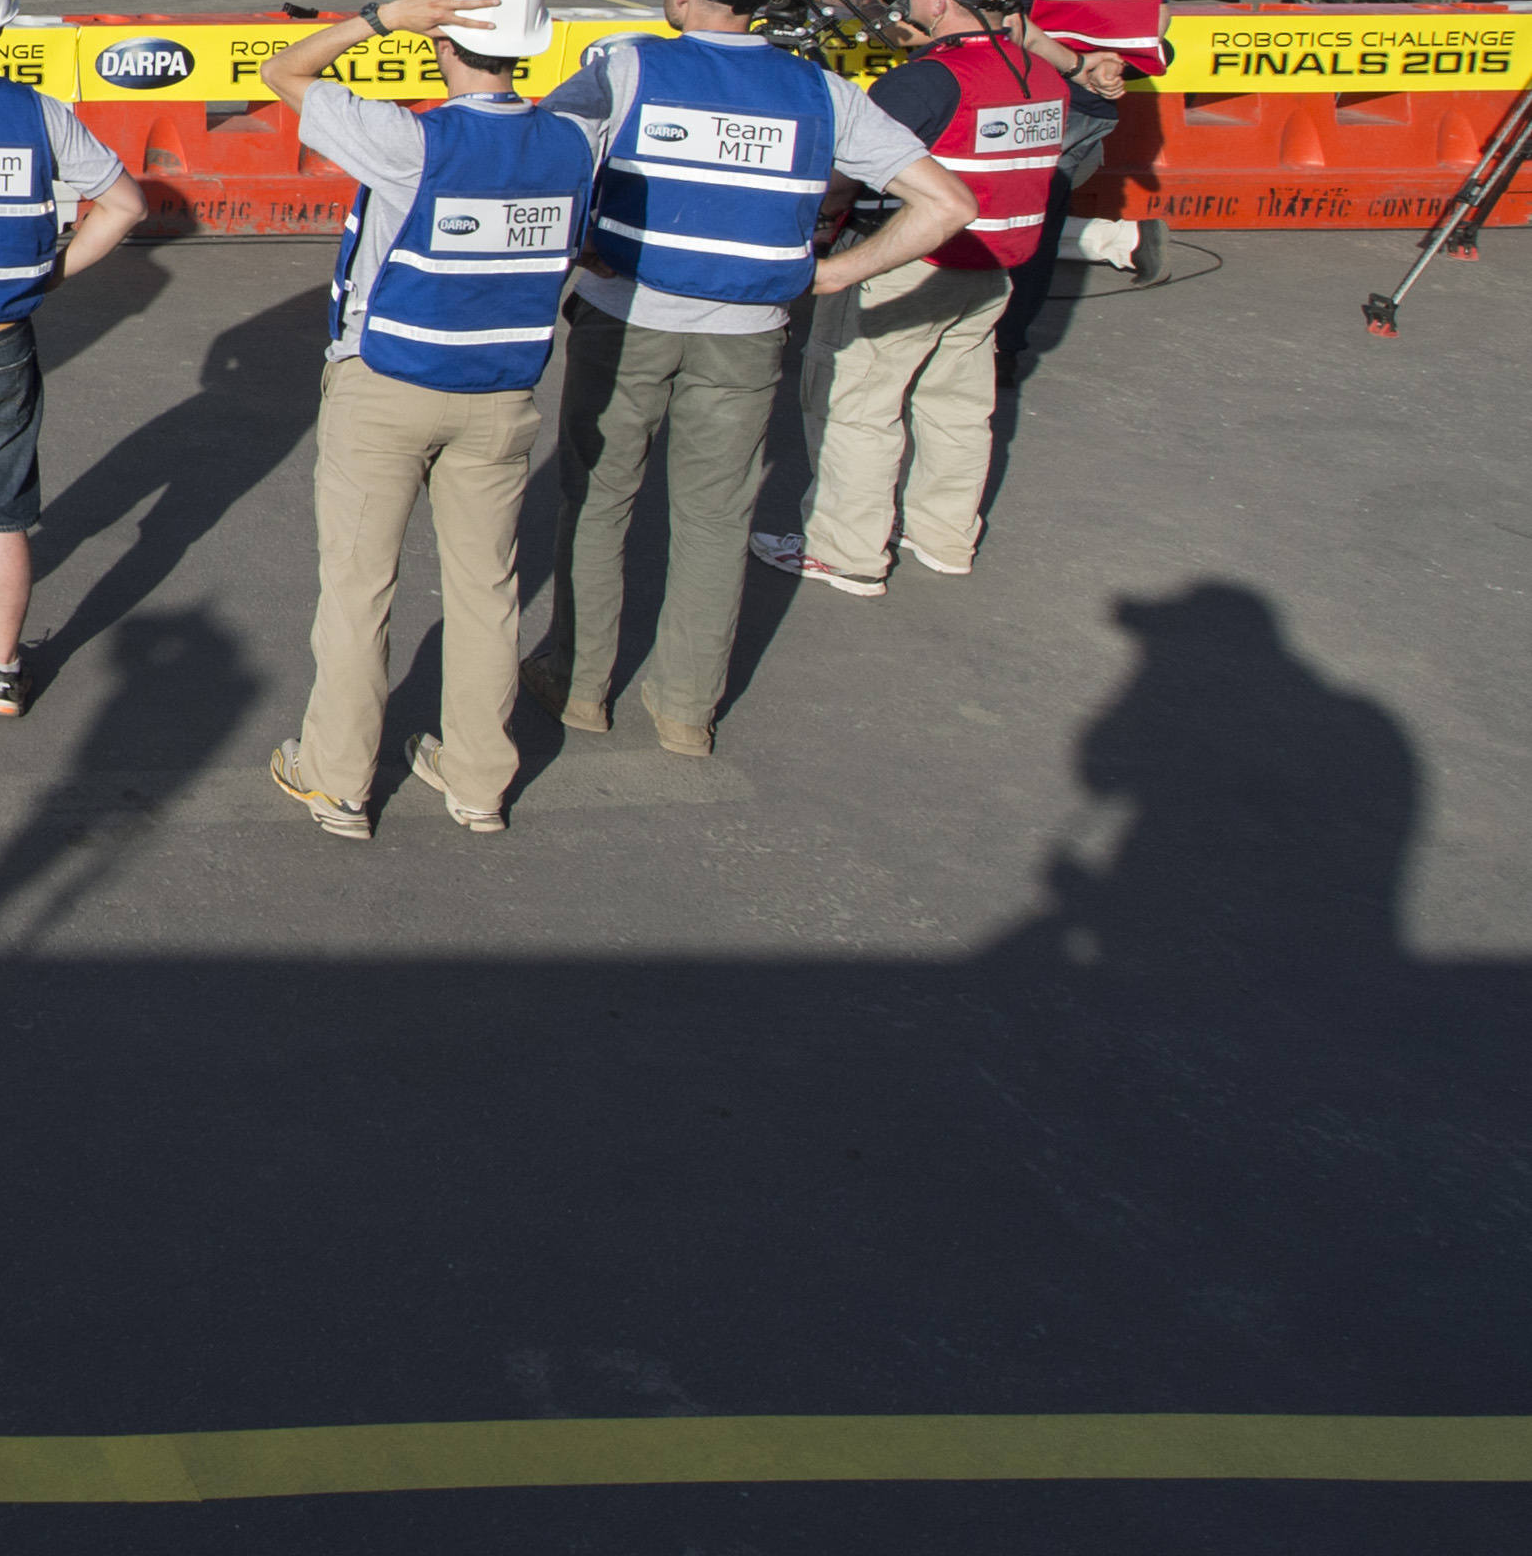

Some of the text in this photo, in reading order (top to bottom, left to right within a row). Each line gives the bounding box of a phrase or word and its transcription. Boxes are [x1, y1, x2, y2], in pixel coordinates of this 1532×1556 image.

[231, 39, 369, 56] ROBS
[1212, 31, 1516, 47] ROBOTICS CHALLENGE
[101, 50, 188, 77] DARPA
[232, 59, 405, 83] FALS
[1211, 51, 1512, 75] FINALS 2015
[1014, 107, 1061, 125] Course
[645, 124, 686, 140] DARPA
[711, 116, 783, 143] Team
[1014, 124, 1059, 144] Official
[718, 140, 772, 164] MIT
[161, 201, 348, 223] PACIFIC TRAFFI
[502, 204, 561, 225] Team
[1147, 196, 1457, 217] PACIFIC TRAFFIC CONTR
[440, 219, 477, 231] DARPA
[507, 226, 552, 247] MIT
